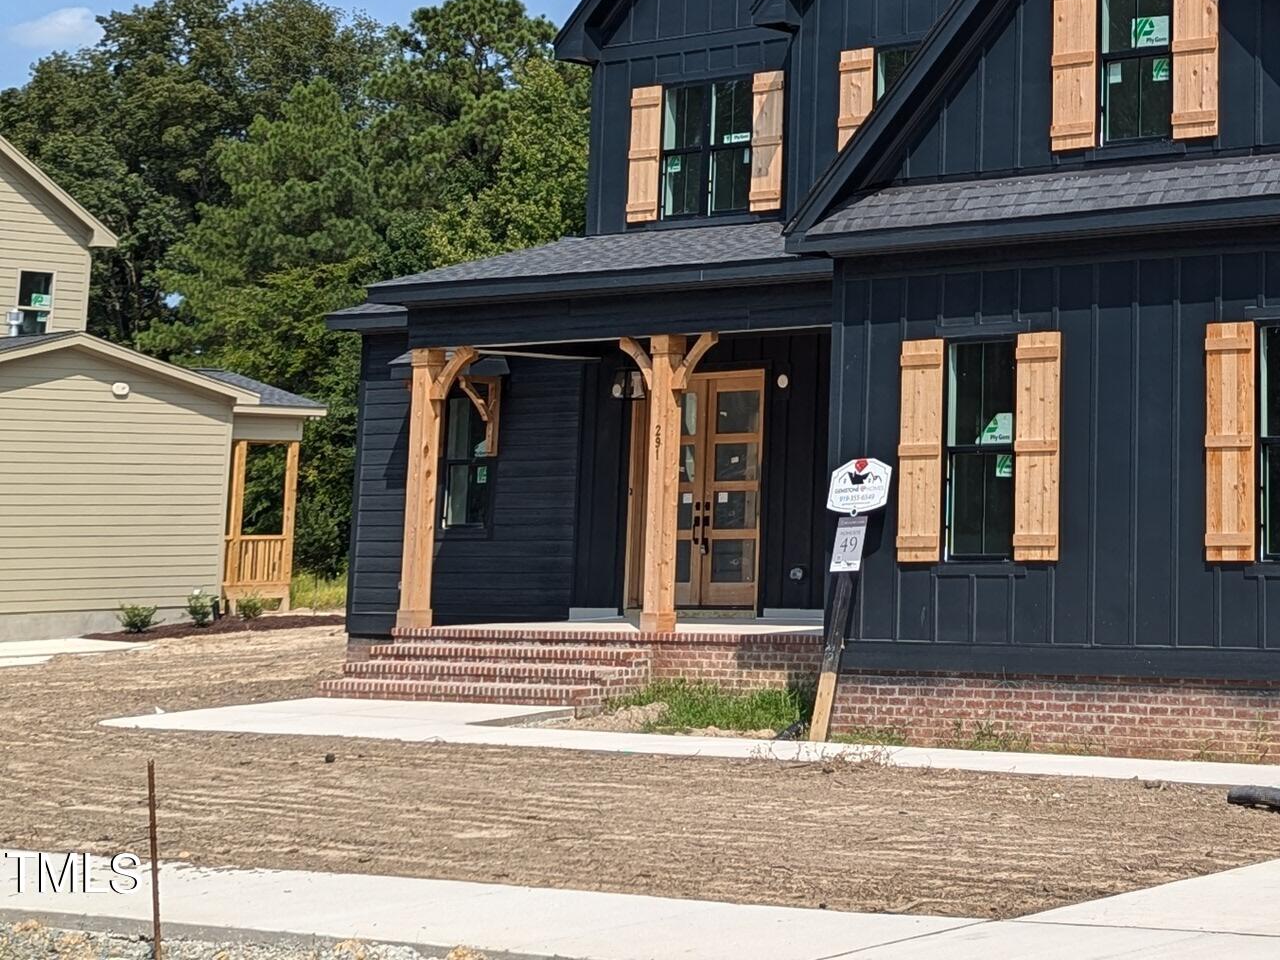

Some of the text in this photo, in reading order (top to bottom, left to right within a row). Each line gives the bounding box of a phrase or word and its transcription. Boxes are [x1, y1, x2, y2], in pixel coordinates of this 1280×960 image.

[654, 424, 662, 461] 291
[990, 433, 1010, 442] Ply Gem
[839, 536, 858, 553] 49
